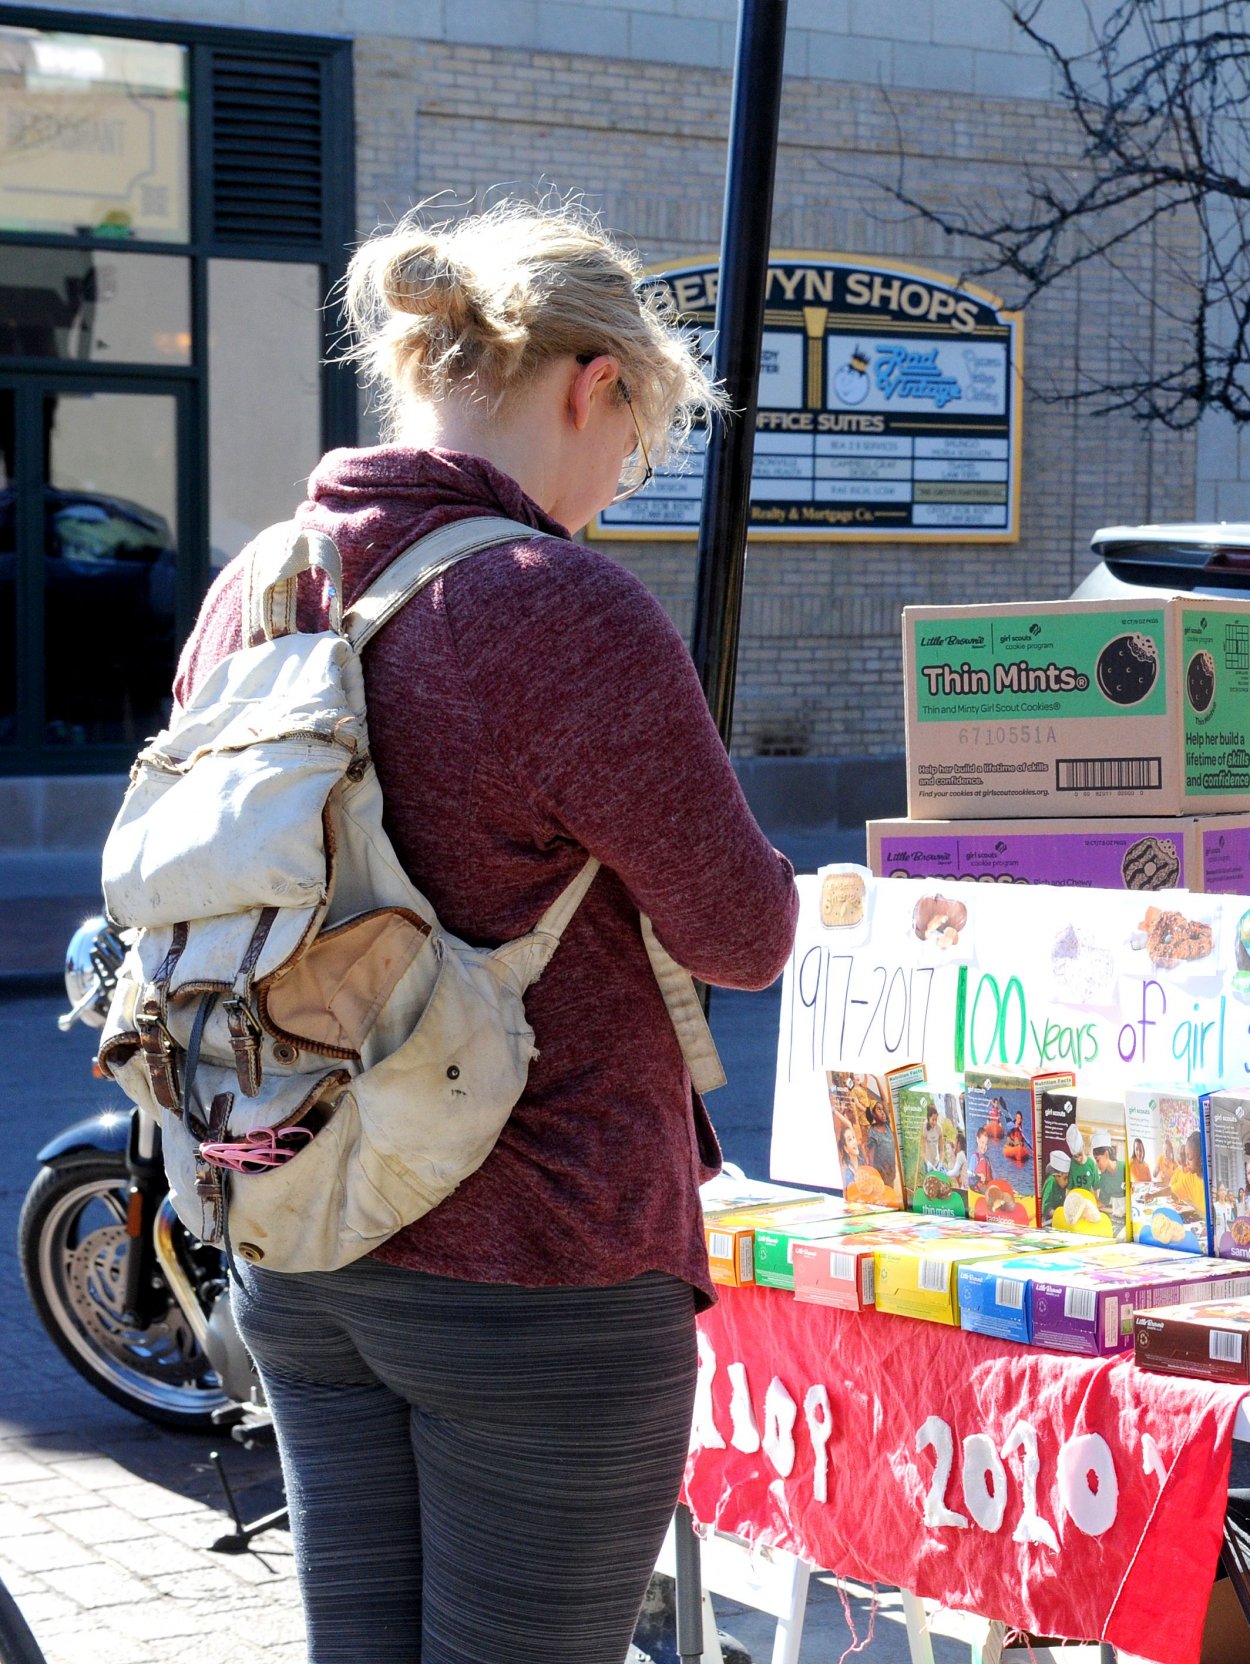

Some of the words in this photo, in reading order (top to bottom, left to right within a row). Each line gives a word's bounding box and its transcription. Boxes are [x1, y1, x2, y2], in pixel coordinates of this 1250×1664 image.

[846, 273, 979, 334] SHOPS
[875, 344, 940, 376] Rad
[877, 375, 962, 408] Vintage
[756, 412, 813, 431] FFICE
[817, 414, 885, 433] SUITES
[788, 506, 799, 519] &
[802, 507, 853, 523] Mortgage
[920, 636, 944, 647] Little
[1000, 635, 1010, 644] girl
[1012, 634, 1032, 642] scouts
[1027, 643, 1053, 651] program
[922, 662, 990, 696] Thin
[922, 706, 940, 715] Thin
[941, 705, 957, 714] and
[958, 705, 979, 715] Minty
[981, 703, 994, 713] Girl
[995, 703, 1019, 712] Scout
[959, 725, 1057, 746] 6710551A
[1186, 732, 1204, 748] Help
[1205, 732, 1218, 745] her
[1219, 732, 1239, 745] build
[1240, 735, 1245, 745] a
[1186, 752, 1216, 766] lifetime
[1217, 752, 1226, 766] of
[1227, 749, 1250, 768] skills
[918, 764, 938, 776] Help
[938, 764, 953, 773] her
[954, 763, 976, 773] build
[977, 765, 982, 773] a
[983, 762, 1016, 773] lifetime
[1017, 762, 1027, 772] of
[1027, 762, 1049, 772] skills
[919, 776, 935, 785] and
[935, 775, 984, 786] confidence.
[1186, 773, 1202, 787] and
[949, 789, 973, 797] cookies
[966, 852, 977, 861] girl
[1067, 878, 1092, 887] Chewy
[788, 944, 934, 1082] 1917-2017
[954, 965, 1027, 1073] 100
[1030, 1016, 1099, 1069] years
[1117, 979, 1167, 1063] of
[1172, 995, 1227, 1083] girl
[1034, 1079, 1057, 1087] Nutrition
[1057, 1077, 1072, 1085] Facts
[1128, 1106, 1136, 1115] girl
[922, 1205, 935, 1215] thin
